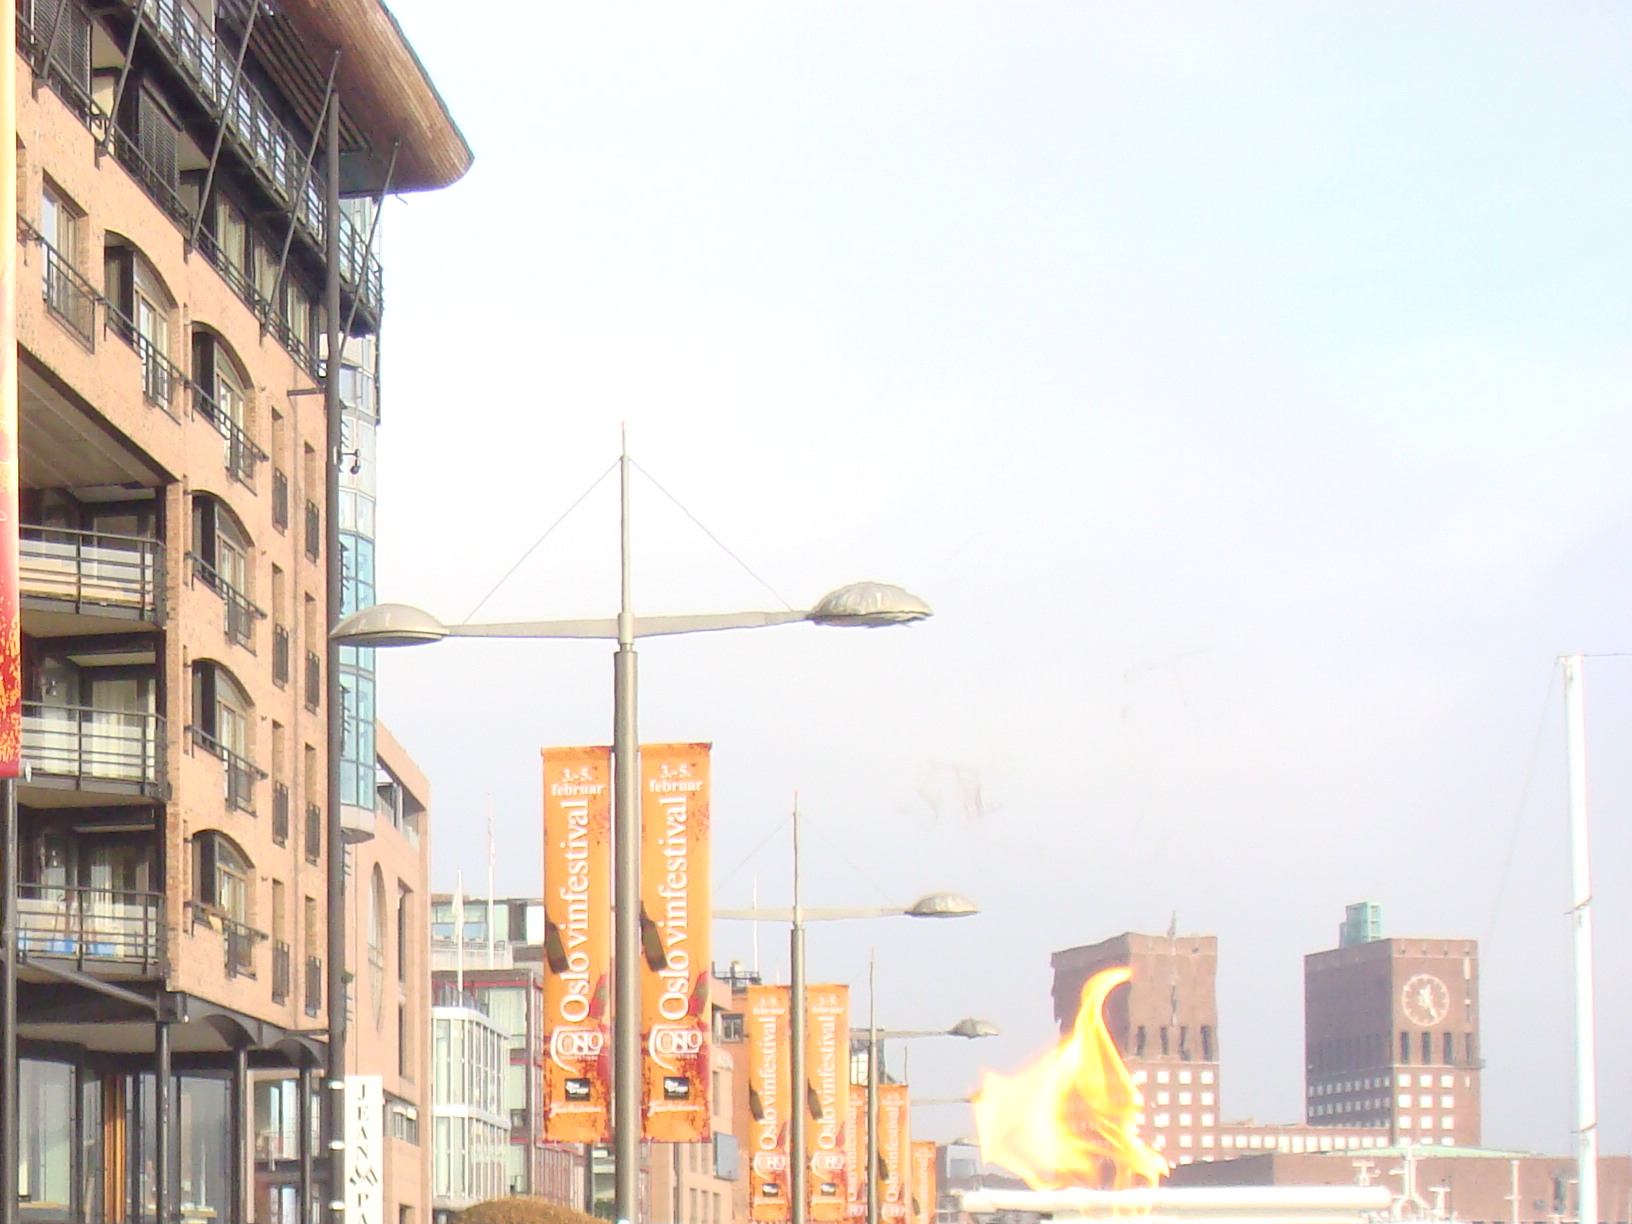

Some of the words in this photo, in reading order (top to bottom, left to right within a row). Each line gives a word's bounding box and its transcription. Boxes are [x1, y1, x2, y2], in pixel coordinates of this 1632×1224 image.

[551, 783, 605, 796] februar
[649, 780, 704, 793] februar
[560, 798, 589, 949] vinfestival
[658, 795, 688, 946] vinfestival
[560, 951, 590, 1022] Oslo
[659, 949, 690, 1021] Oslo
[758, 1016, 777, 1107] vinfestival
[817, 1016, 836, 1106] vinfestival
[356, 1082, 369, 1161] JEAN
[759, 1108, 777, 1150] Oslo
[817, 1107, 836, 1150] Oslo
